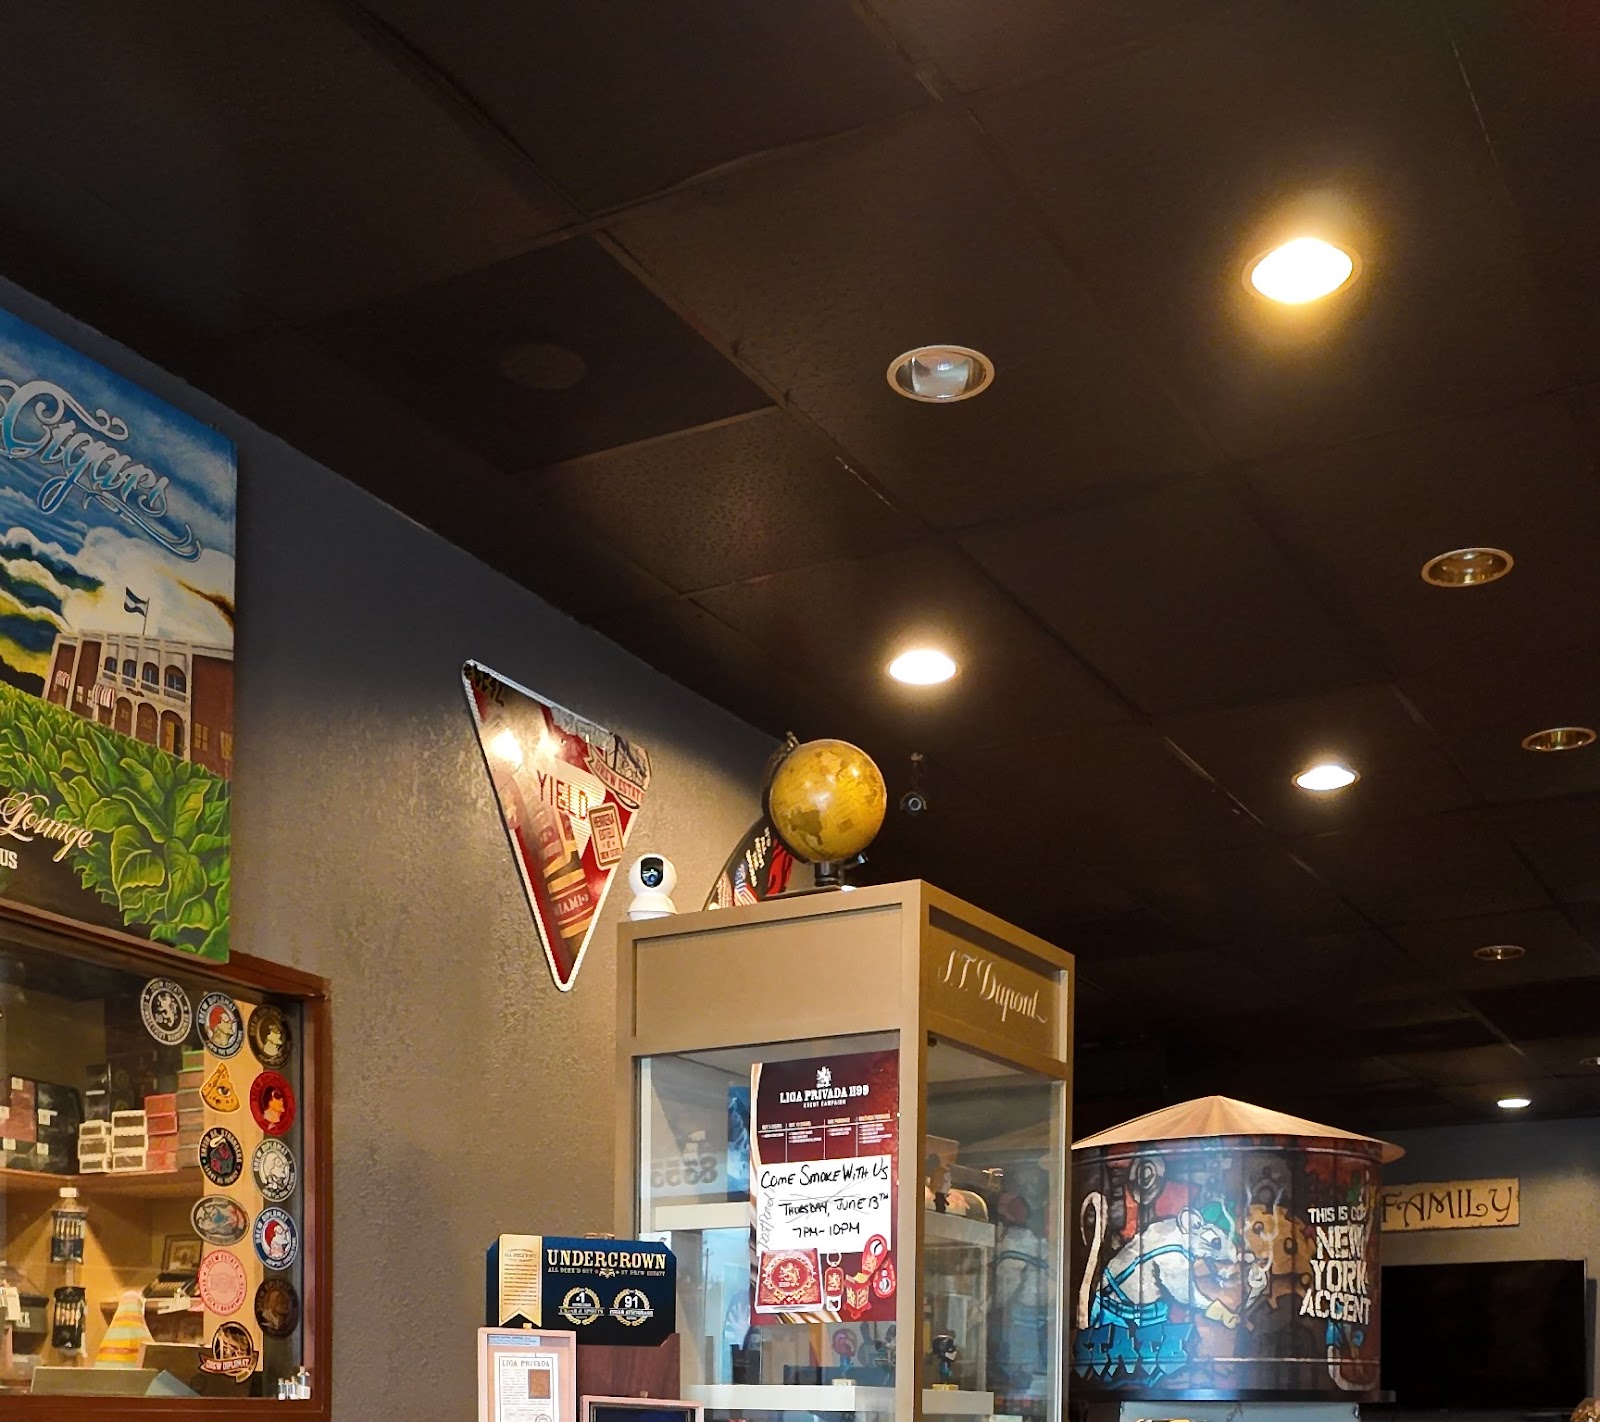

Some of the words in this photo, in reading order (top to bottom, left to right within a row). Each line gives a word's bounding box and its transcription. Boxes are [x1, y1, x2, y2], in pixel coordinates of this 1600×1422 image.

[1, 380, 170, 517] Cigars
[537, 769, 589, 819] YIELD
[0, 791, 93, 863] Lounge
[780, 1091, 803, 1104] LIGA
[804, 1087, 848, 1102] PRIVADA
[873, 1157, 889, 1180] US
[1307, 1206, 1335, 1223] THIS
[1338, 1205, 1348, 1221] IS
[1382, 1186, 1512, 1227] FAMILY
[547, 1249, 667, 1270] UNDERCROWN
[1315, 1224, 1364, 1260] NEW
[1310, 1260, 1367, 1295] YORK
[624, 1295, 639, 1309] 91
[1299, 1288, 1371, 1326] ACCENT
[502, 1359, 518, 1367] LIGA
